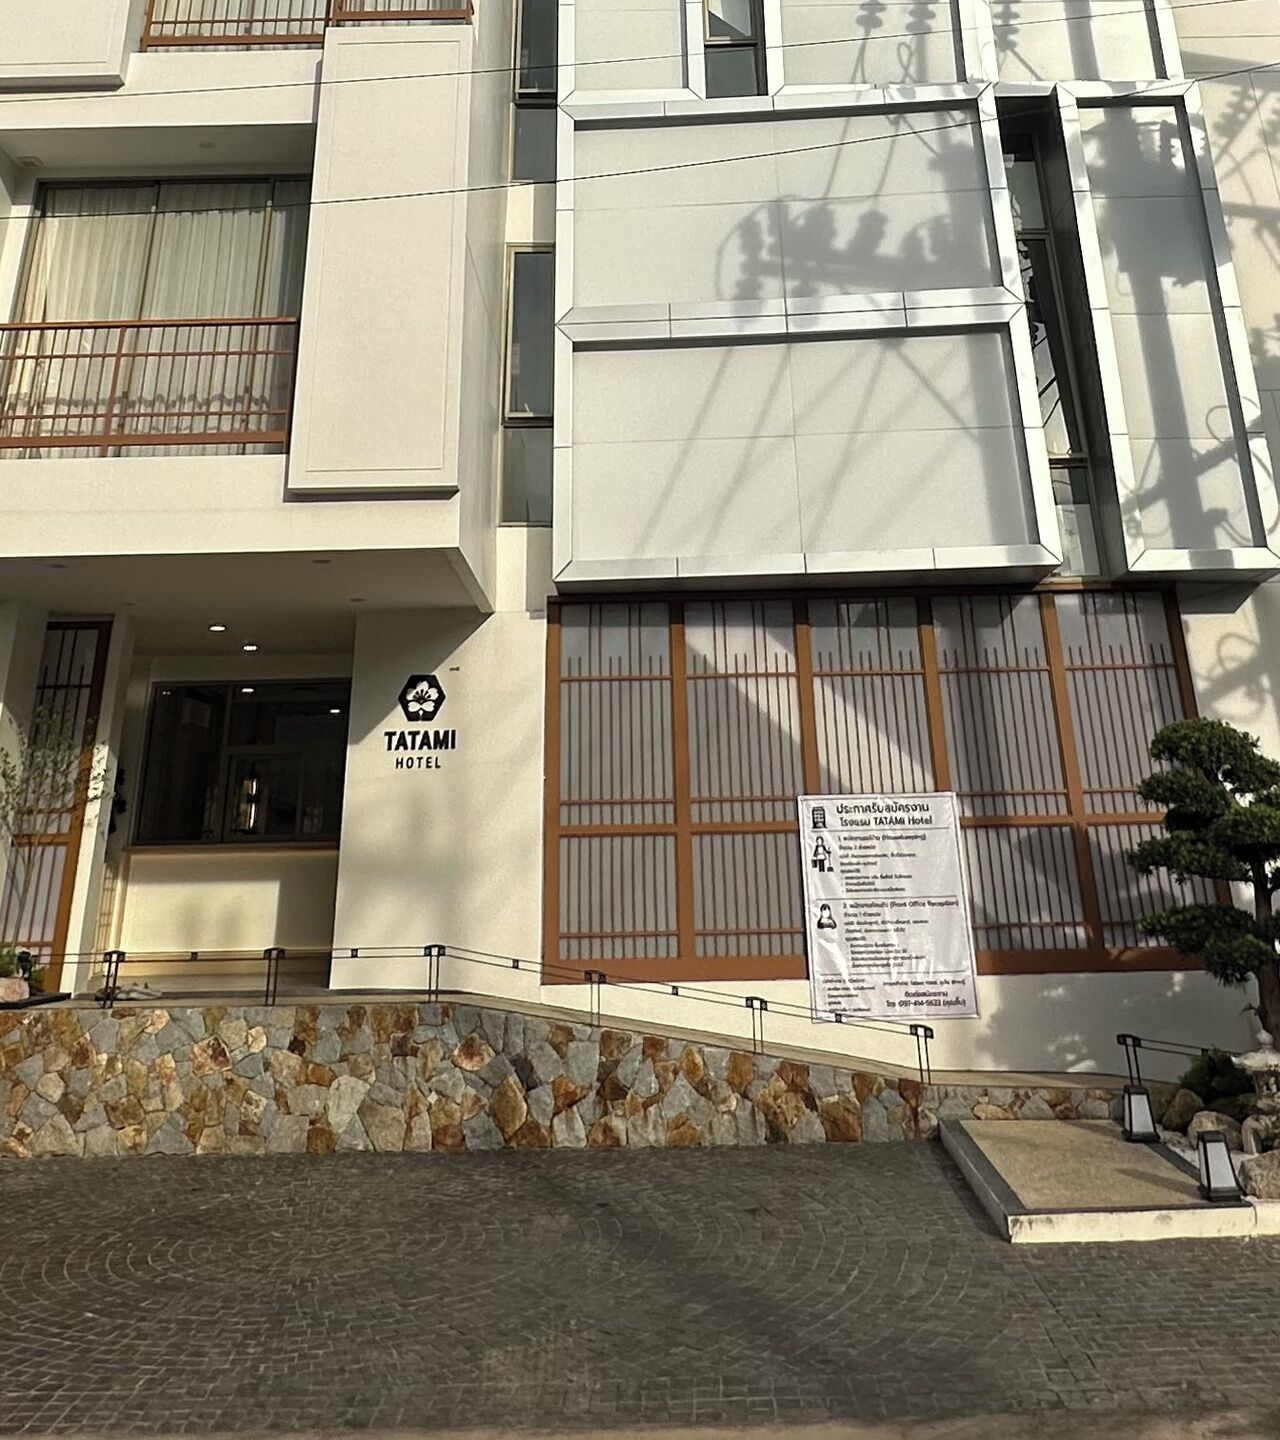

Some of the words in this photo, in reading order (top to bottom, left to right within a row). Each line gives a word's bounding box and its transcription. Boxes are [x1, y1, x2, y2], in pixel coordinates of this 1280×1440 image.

[384, 730, 456, 751] TATAMI
[395, 756, 441, 769] HOTEL
[840, 815, 871, 827] โรงแรม
[908, 815, 933, 825] Hotel
